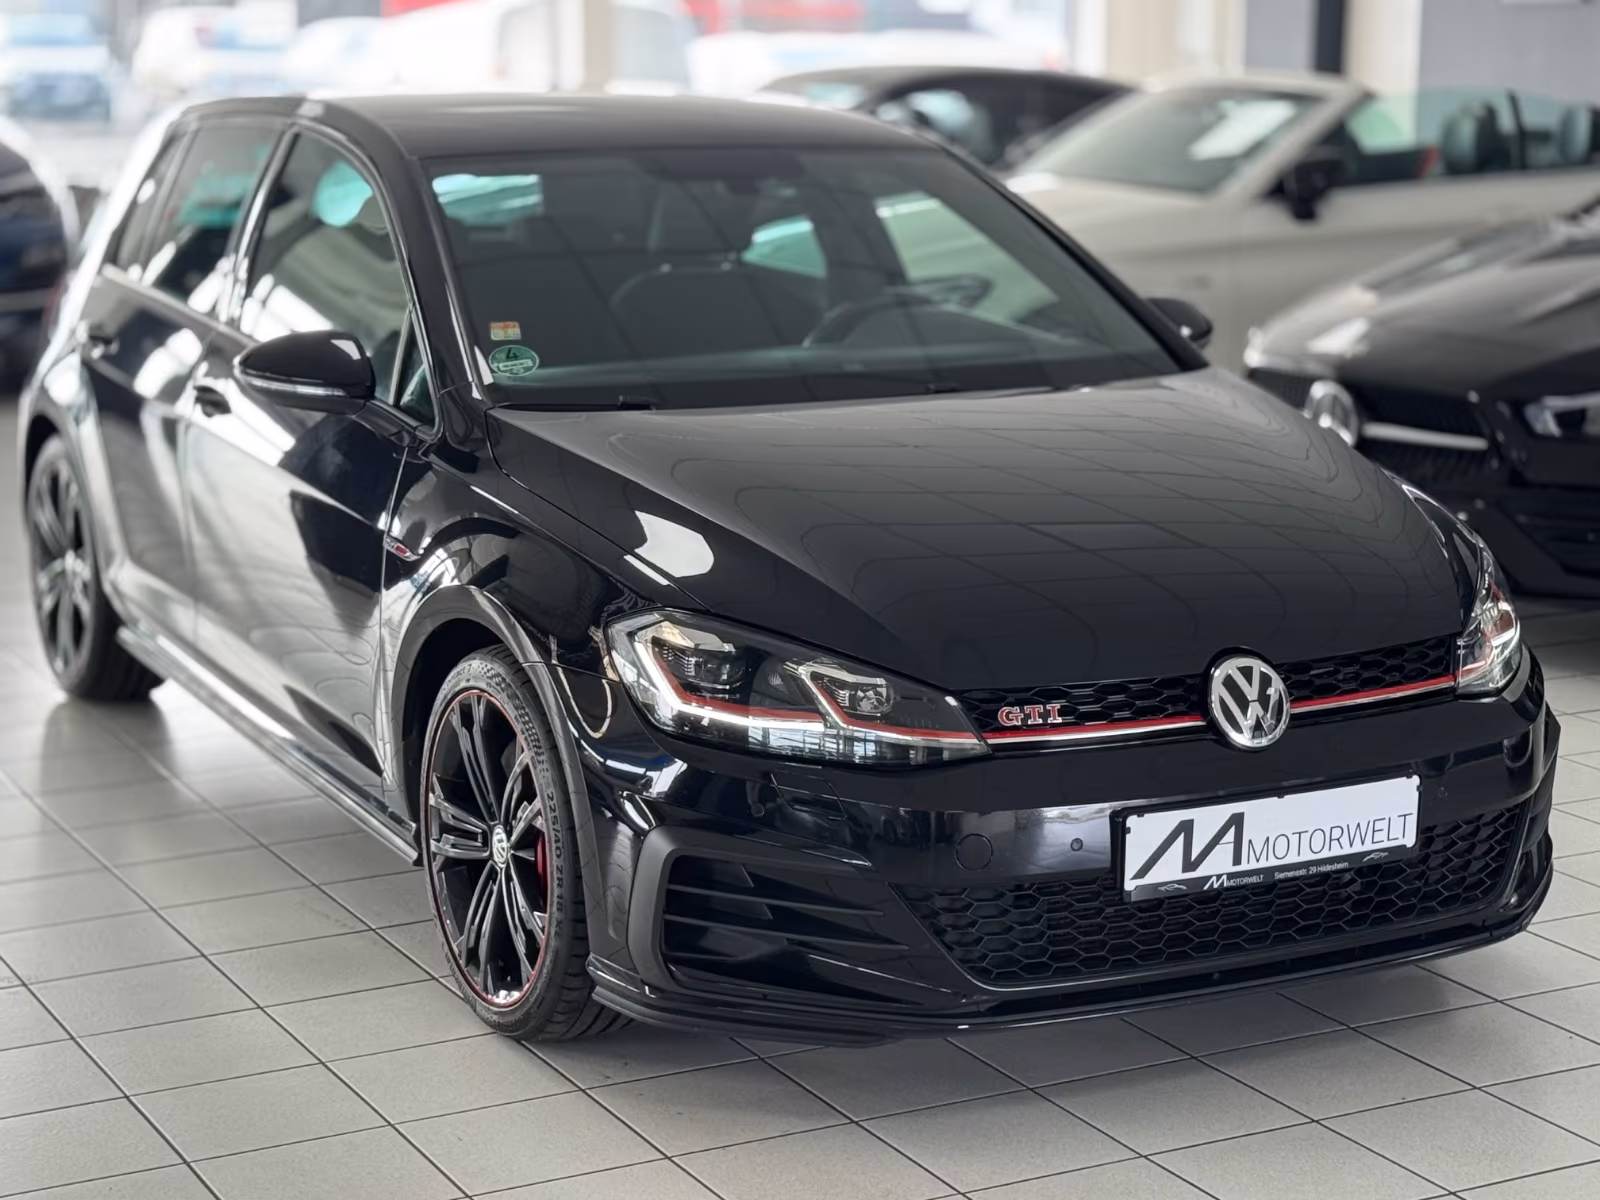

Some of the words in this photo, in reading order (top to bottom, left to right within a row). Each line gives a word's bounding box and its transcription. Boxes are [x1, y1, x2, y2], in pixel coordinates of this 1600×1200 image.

[998, 704, 1062, 727] GTI
[546, 791, 565, 859] 225/40
[1246, 813, 1413, 864] MOTORWELT
[1227, 874, 1264, 886] MOTORWELT
[1308, 866, 1317, 874] 29
[1317, 861, 1349, 872] Hildesheim
